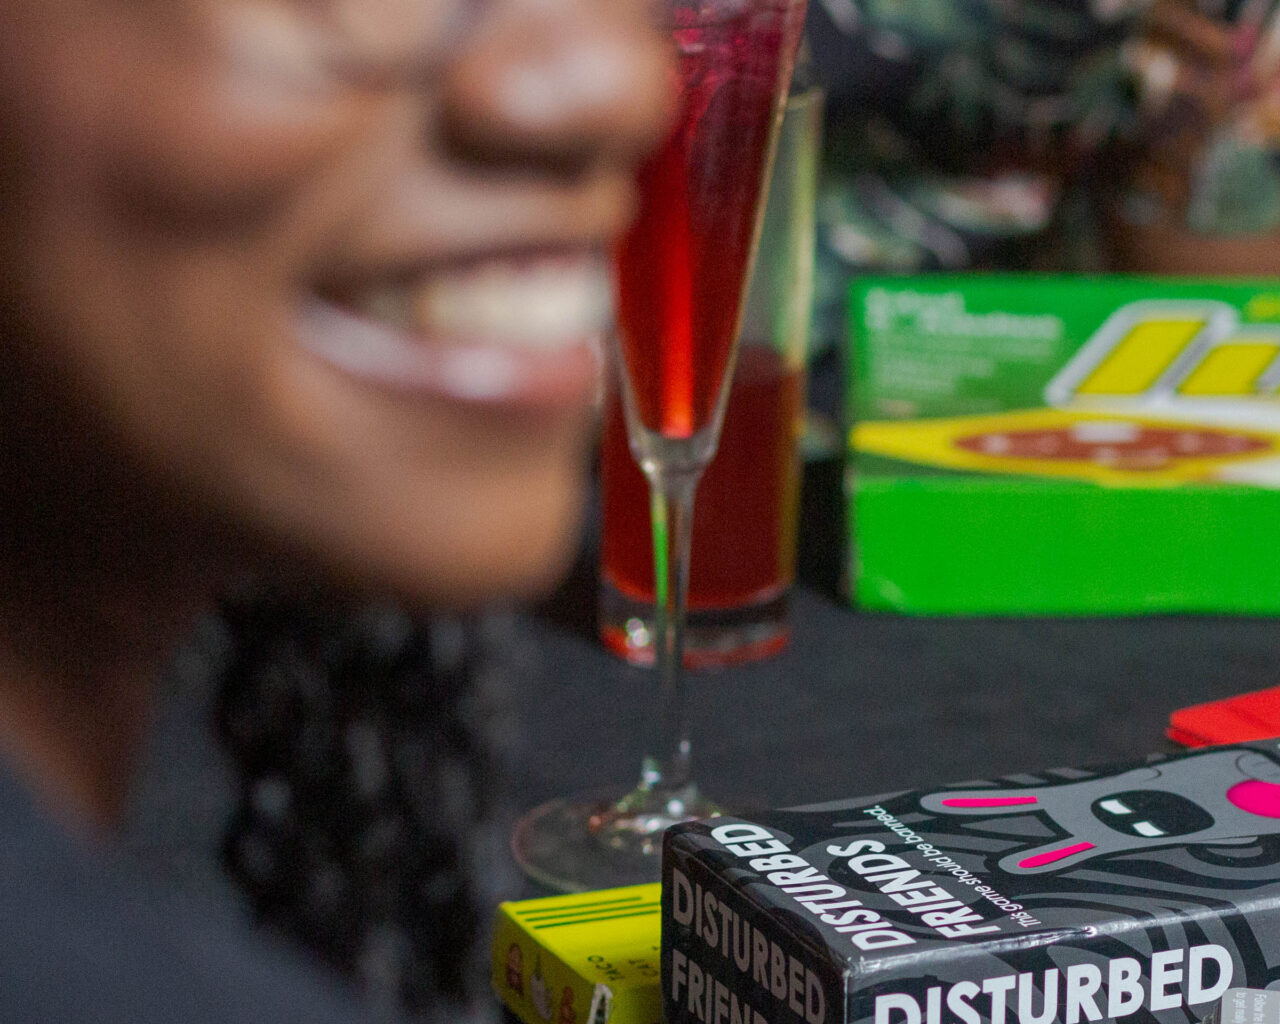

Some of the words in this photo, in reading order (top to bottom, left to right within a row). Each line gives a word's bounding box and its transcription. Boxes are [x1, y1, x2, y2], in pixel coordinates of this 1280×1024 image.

[863, 805, 925, 844] banned.
[916, 843, 943, 858] be
[929, 855, 982, 886] should
[711, 823, 917, 951] DISTURBED
[826, 839, 1002, 939] FRIENDS
[974, 885, 1024, 912] game
[1009, 910, 1042, 928] This
